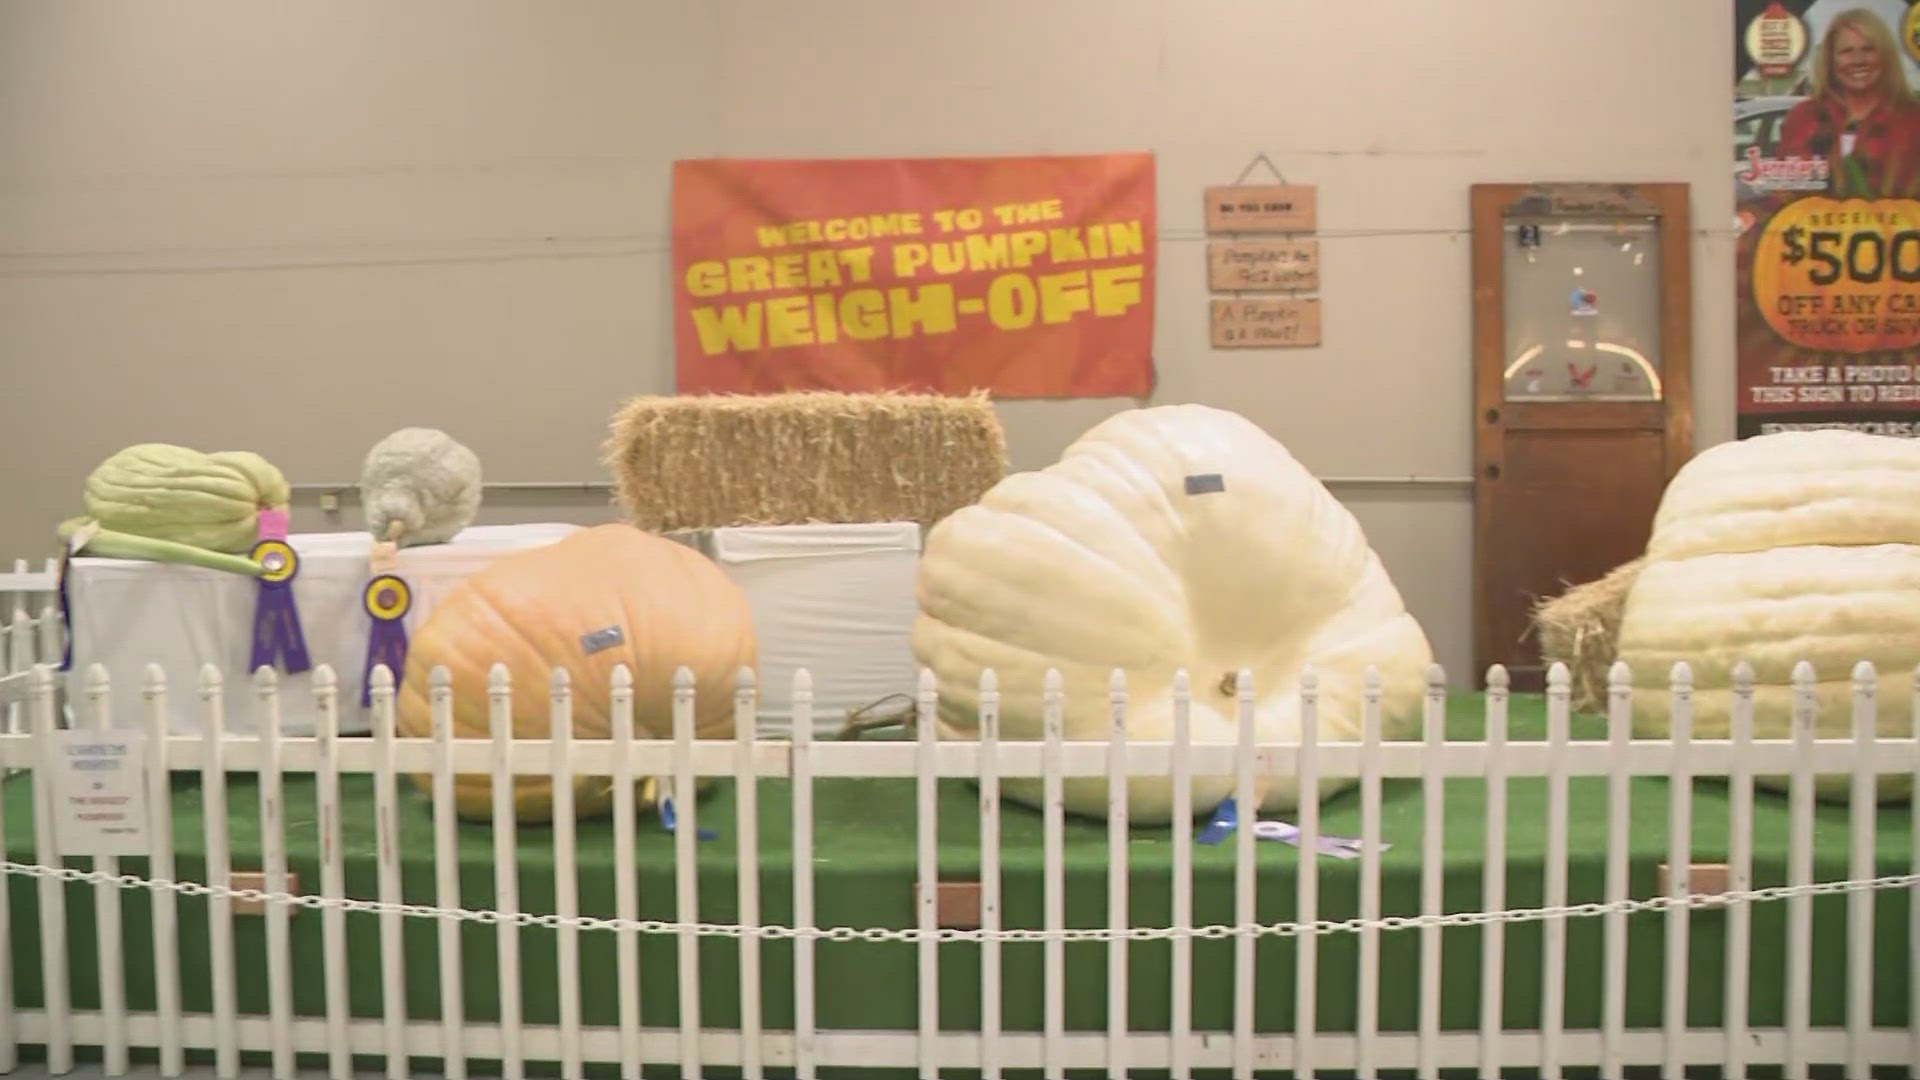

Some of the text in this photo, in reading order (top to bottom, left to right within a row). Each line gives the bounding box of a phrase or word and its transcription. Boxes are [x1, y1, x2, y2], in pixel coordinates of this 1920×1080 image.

[756, 199, 1063, 247] WELCOME TO THE
[1810, 212, 1899, 225] RECEIVE
[685, 220, 1144, 297] GREAT PUMPKIN
[1781, 224, 1920, 285] $500
[690, 264, 1145, 355] WEIGH-OFF
[1778, 294, 1920, 315] OFF ANY CA
[1769, 367, 1825, 383] TAKE
[1826, 366, 1842, 383] A
[1844, 365, 1912, 382] PHOTO
[1751, 386, 1796, 402] THIS
[1798, 386, 1844, 402] SIGN
[1846, 385, 1876, 402] TO
